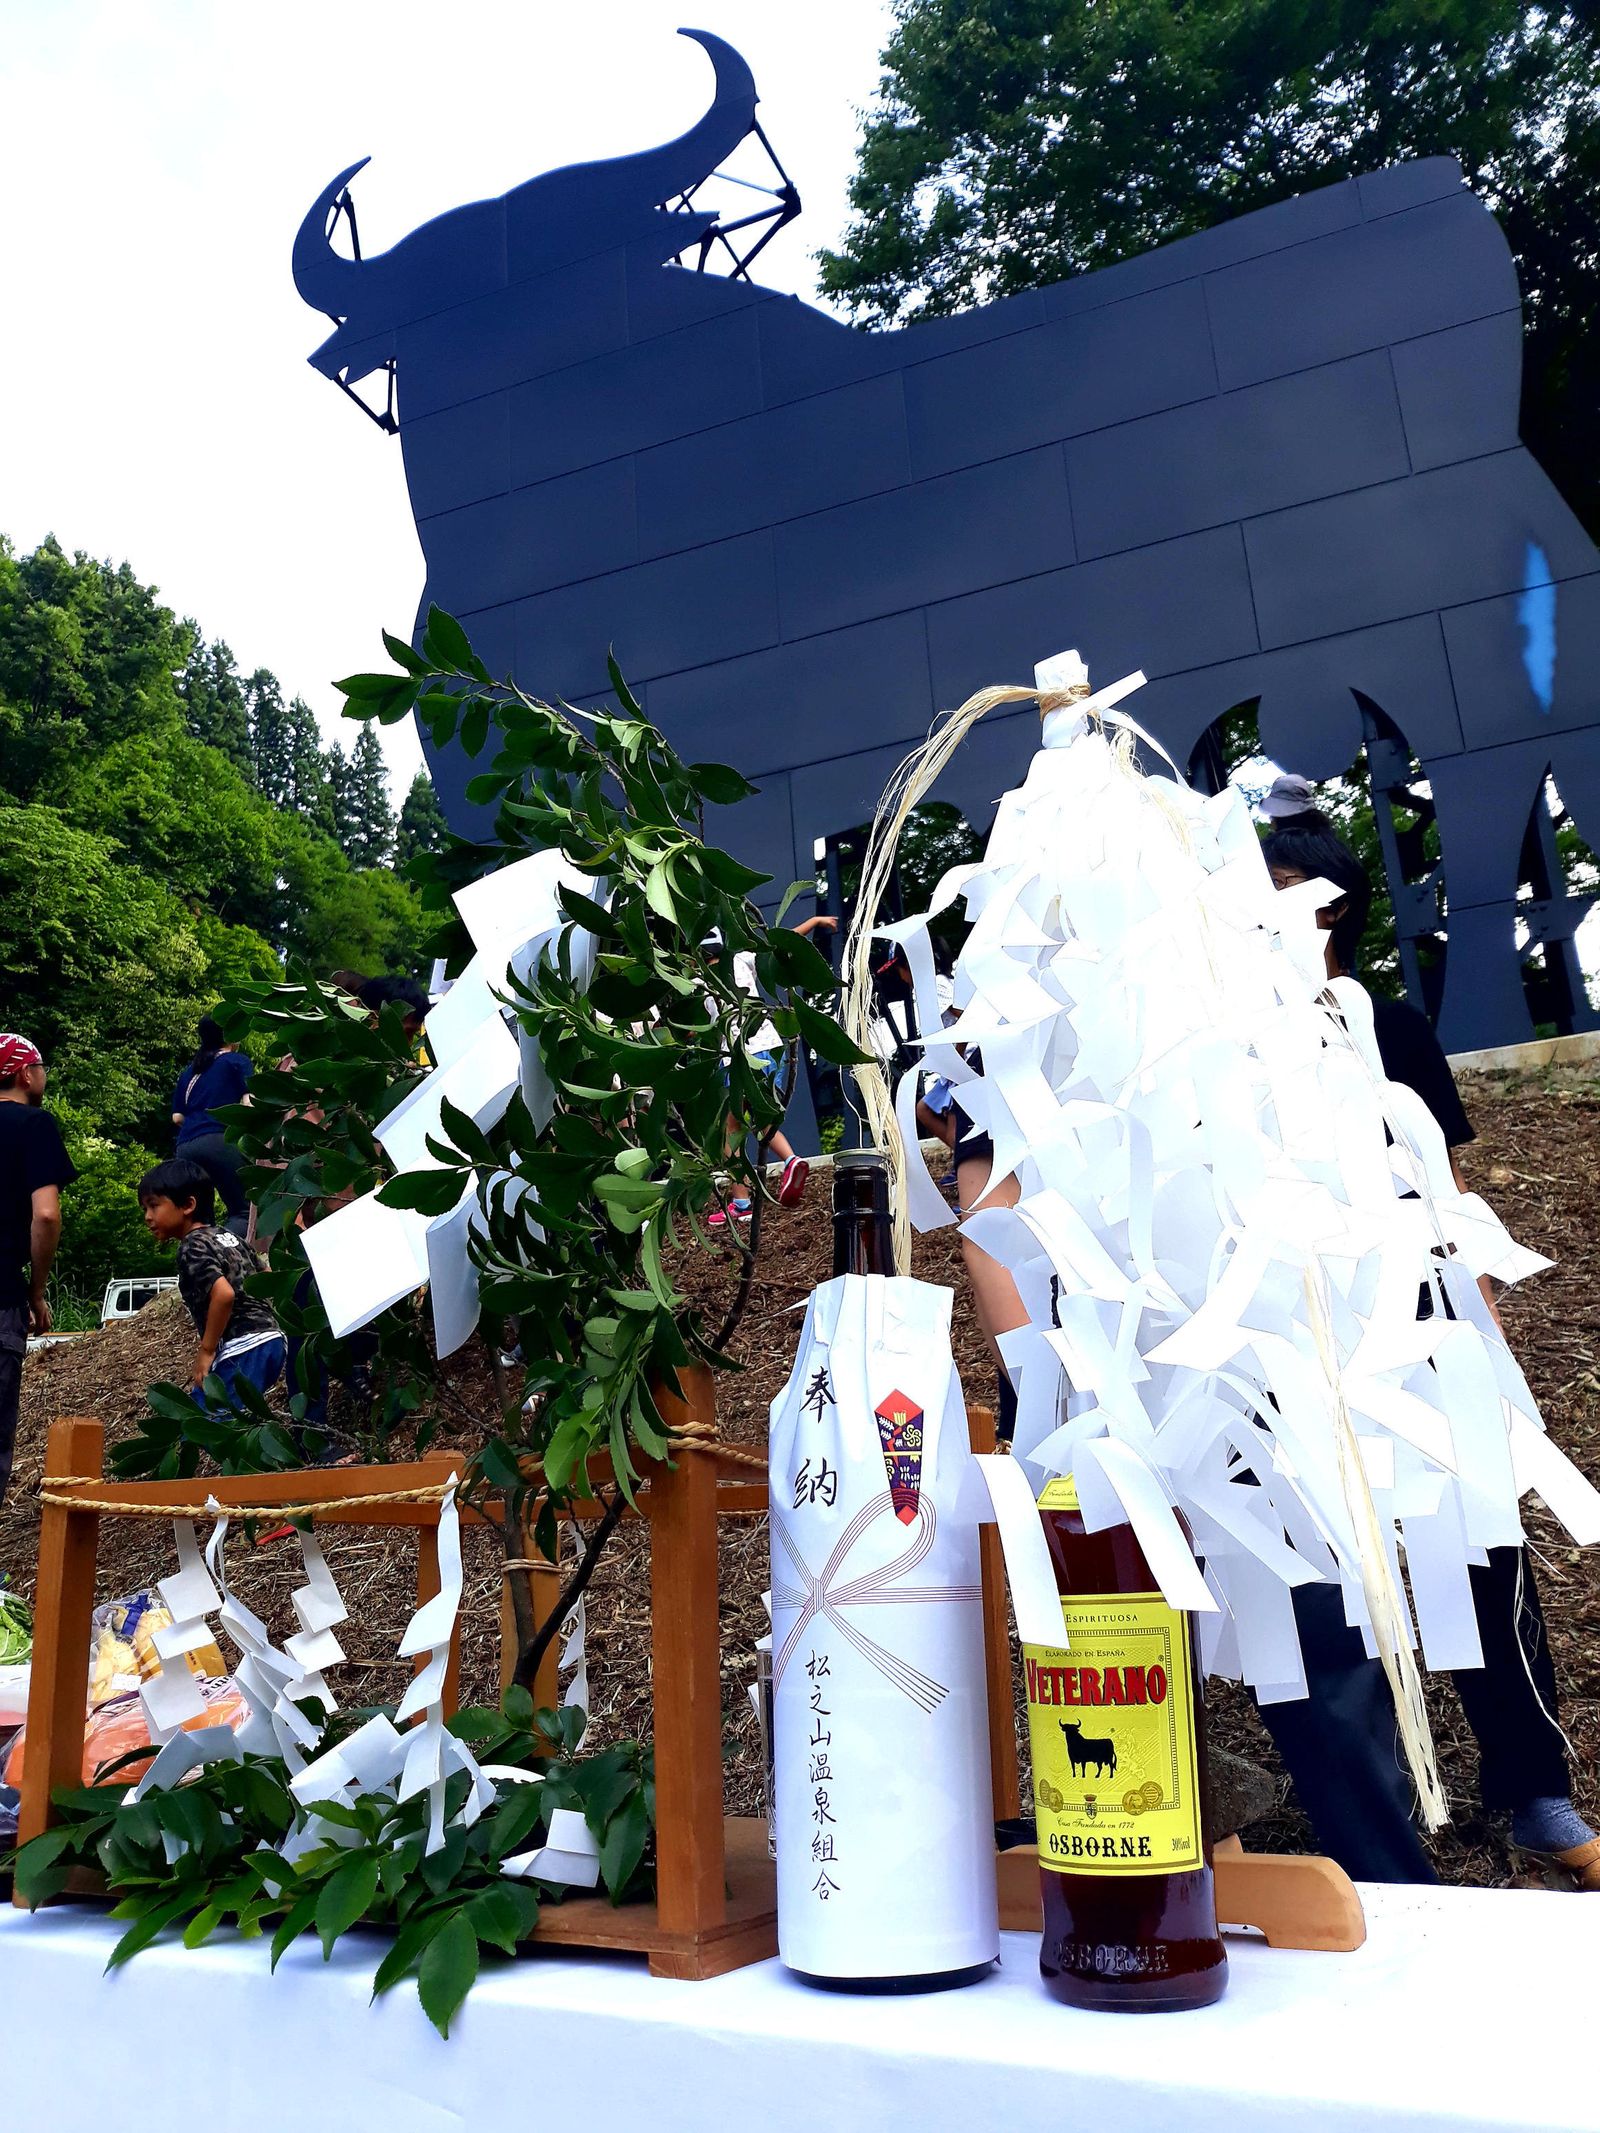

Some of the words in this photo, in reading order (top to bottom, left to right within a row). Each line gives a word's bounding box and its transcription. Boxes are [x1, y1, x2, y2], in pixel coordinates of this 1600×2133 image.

[792, 1365, 838, 1510] 奉納
[1066, 1613, 1138, 1624] ESPIRITUOSA
[1045, 1649, 1082, 1658] ELABORADO
[1085, 1650, 1094, 1658] EN
[1097, 1649, 1126, 1657] ESPAÑA
[1026, 1657, 1167, 1706] VETERANO
[804, 1648, 842, 1901] 松之山温泉組合
[1118, 1821, 1135, 1829] 1772
[1049, 1833, 1152, 1858] OSBORNE
